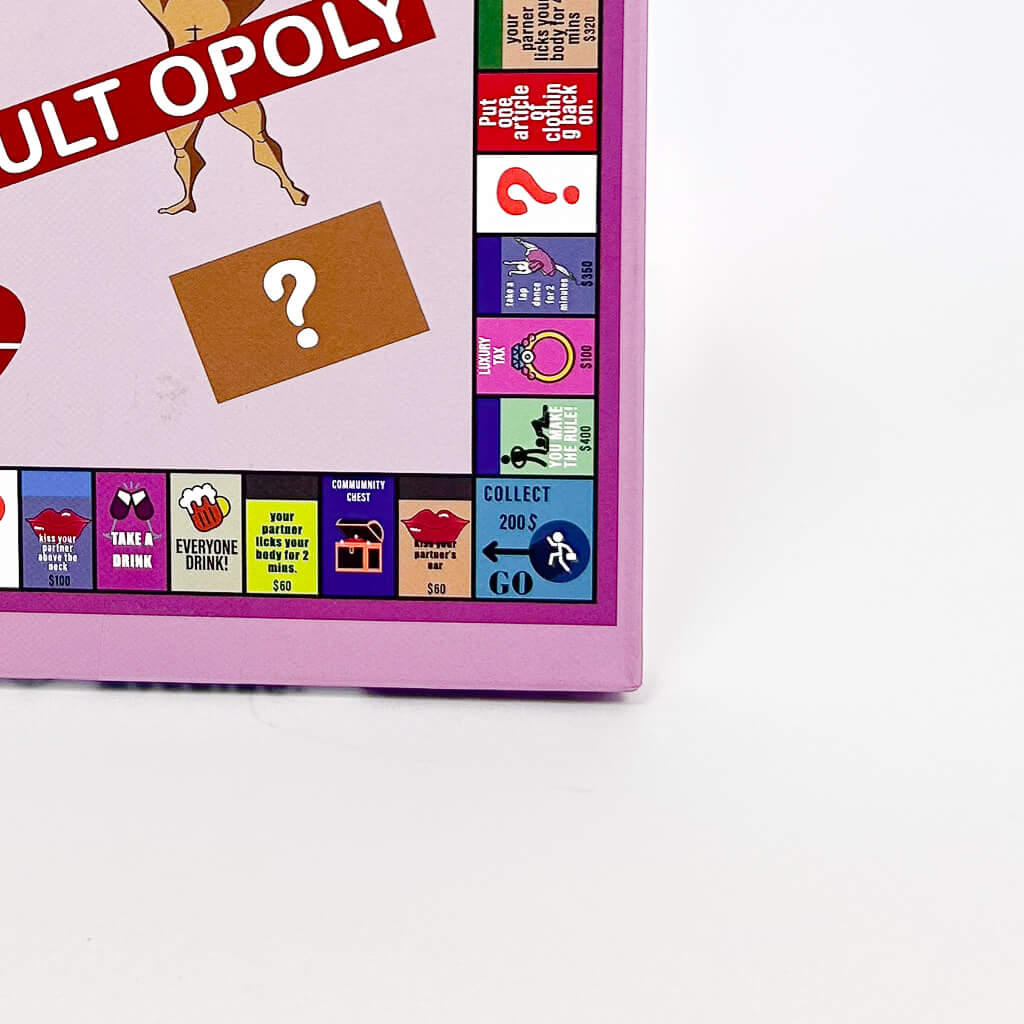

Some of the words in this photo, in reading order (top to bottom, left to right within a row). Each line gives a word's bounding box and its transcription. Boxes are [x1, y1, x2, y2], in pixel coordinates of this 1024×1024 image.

[549, 7, 565, 25] for
[506, 14, 521, 45] your
[521, 7, 535, 51] parner
[565, 12, 580, 45] mins
[583, 16, 596, 42] $320
[534, 30, 549, 61] licks
[550, 30, 566, 61] body
[479, 98, 497, 127] Put
[498, 97, 513, 128] one
[511, 84, 529, 140] article
[528, 104, 544, 120] of
[542, 83, 561, 142] clothin
[560, 84, 578, 124] back
[578, 99, 594, 125] on.
[561, 129, 581, 139] g
[478, 337, 491, 375] LUXURY
[493, 347, 505, 365] TAX
[580, 345, 592, 369] $100
[550, 406, 563, 440] MAKE
[564, 406, 577, 442] RULE!
[580, 425, 592, 452] $400
[549, 442, 563, 468] YOU
[564, 445, 577, 468] THE
[484, 485, 551, 502] COLLECT
[269, 512, 295, 523] your
[110, 531, 142, 546] TAKE
[144, 532, 154, 546] A
[261, 524, 303, 536] partner
[176, 539, 238, 555] EVERYONE
[255, 536, 282, 548] licks
[284, 538, 309, 549] your
[112, 554, 153, 569] DRINK
[185, 555, 228, 571] DRINK!
[255, 549, 282, 561] body
[284, 550, 300, 561] for
[302, 550, 309, 561] 2
[267, 562, 298, 574] mins.
[273, 580, 292, 592] $60
[427, 582, 446, 595] $60
[489, 570, 534, 595] GO
